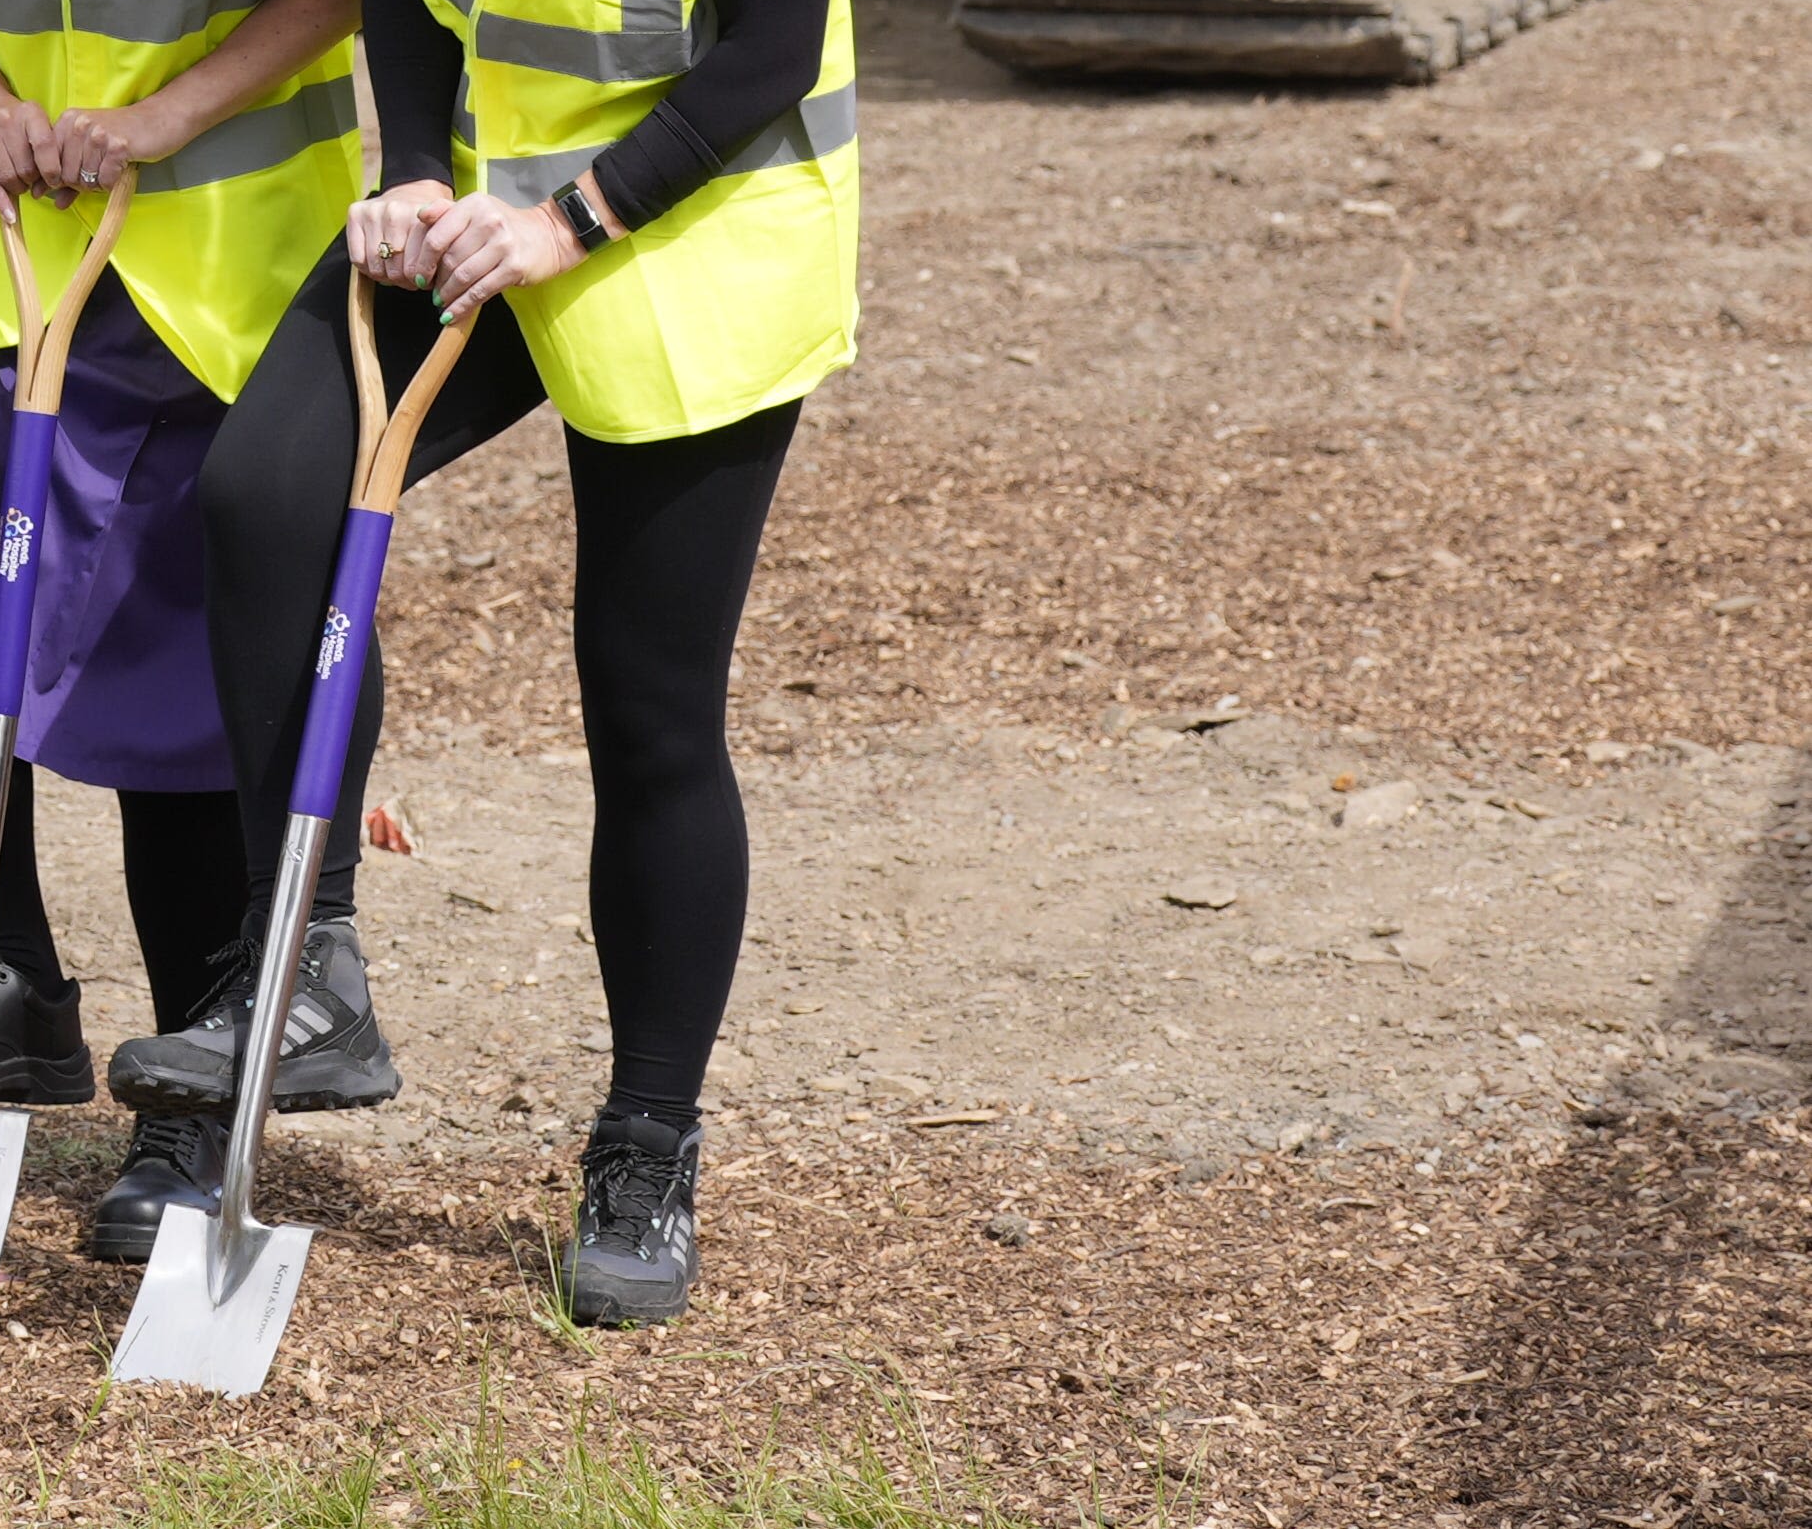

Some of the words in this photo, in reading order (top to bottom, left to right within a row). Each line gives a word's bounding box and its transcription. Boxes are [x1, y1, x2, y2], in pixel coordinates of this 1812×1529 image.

[0, 539, 12, 575] Charity
[7, 538, 21, 582] Hospitals
[19, 535, 32, 564] Leeds
[316, 637, 328, 673] Charity
[321, 635, 336, 680] Hospitals
[333, 632, 348, 662] Leeds
[271, 1263, 289, 1295] Kent
[255, 1305, 276, 1344] Stowe
